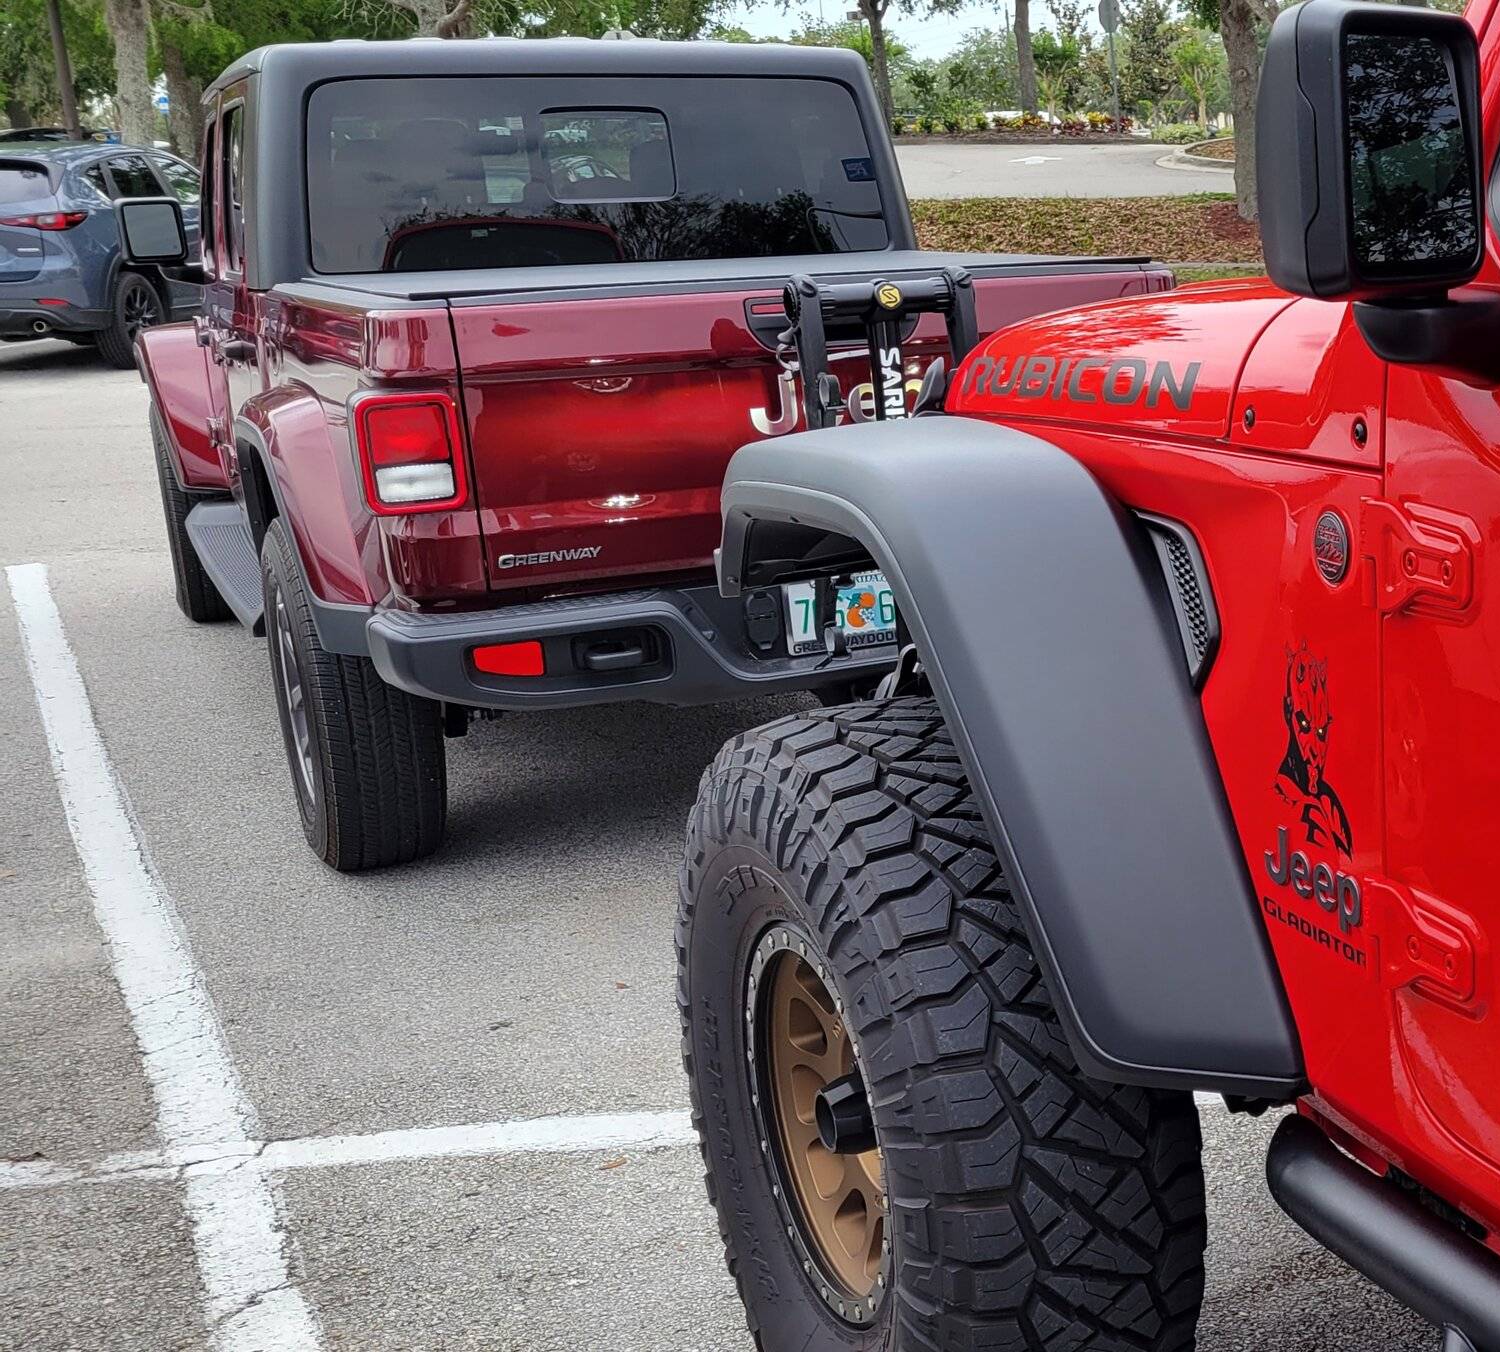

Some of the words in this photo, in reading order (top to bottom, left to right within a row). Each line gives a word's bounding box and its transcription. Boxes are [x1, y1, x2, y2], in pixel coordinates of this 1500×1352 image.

[880, 347, 907, 420] SARI
[961, 356, 1202, 412] RUBICON
[498, 545, 602, 569] GREENWAY
[1264, 825, 1362, 936] Jeep
[1263, 896, 1367, 967] GLADIATOR
